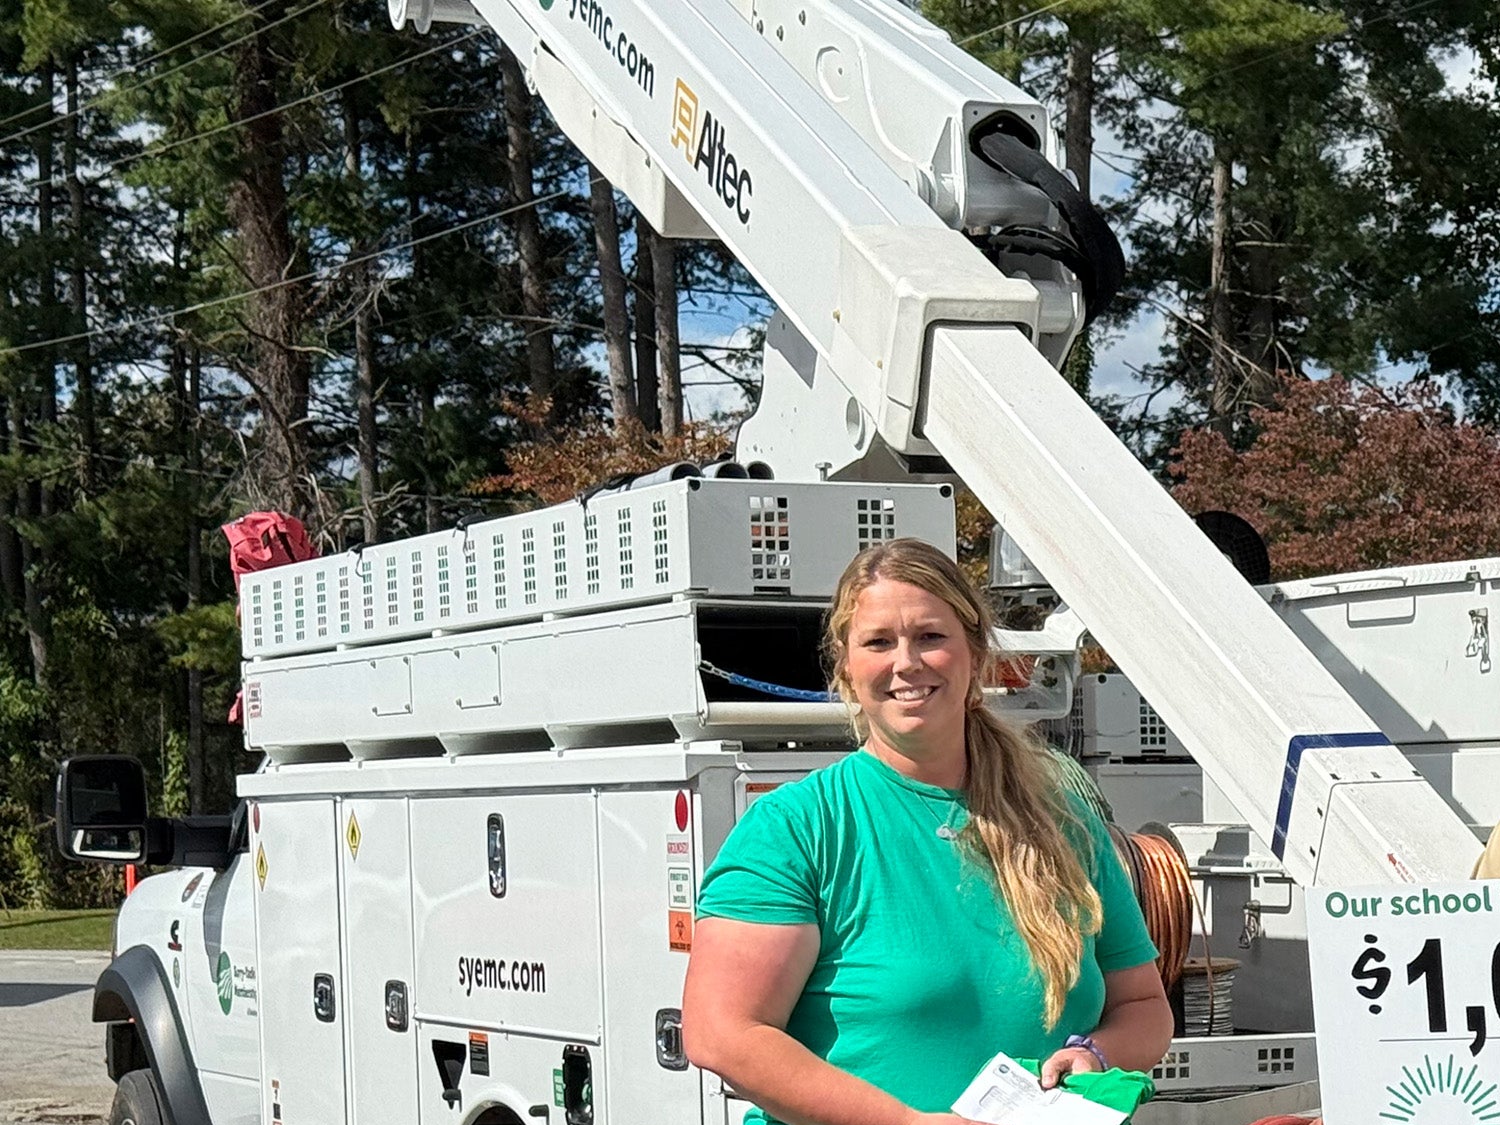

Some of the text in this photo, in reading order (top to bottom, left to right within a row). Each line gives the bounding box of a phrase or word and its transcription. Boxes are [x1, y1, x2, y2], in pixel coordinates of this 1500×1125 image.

[566, 0, 655, 99] emc.com
[694, 110, 752, 224] Altec
[1325, 891, 1382, 918] Our
[1391, 886, 1492, 916] school
[458, 956, 546, 997] syemc.com
